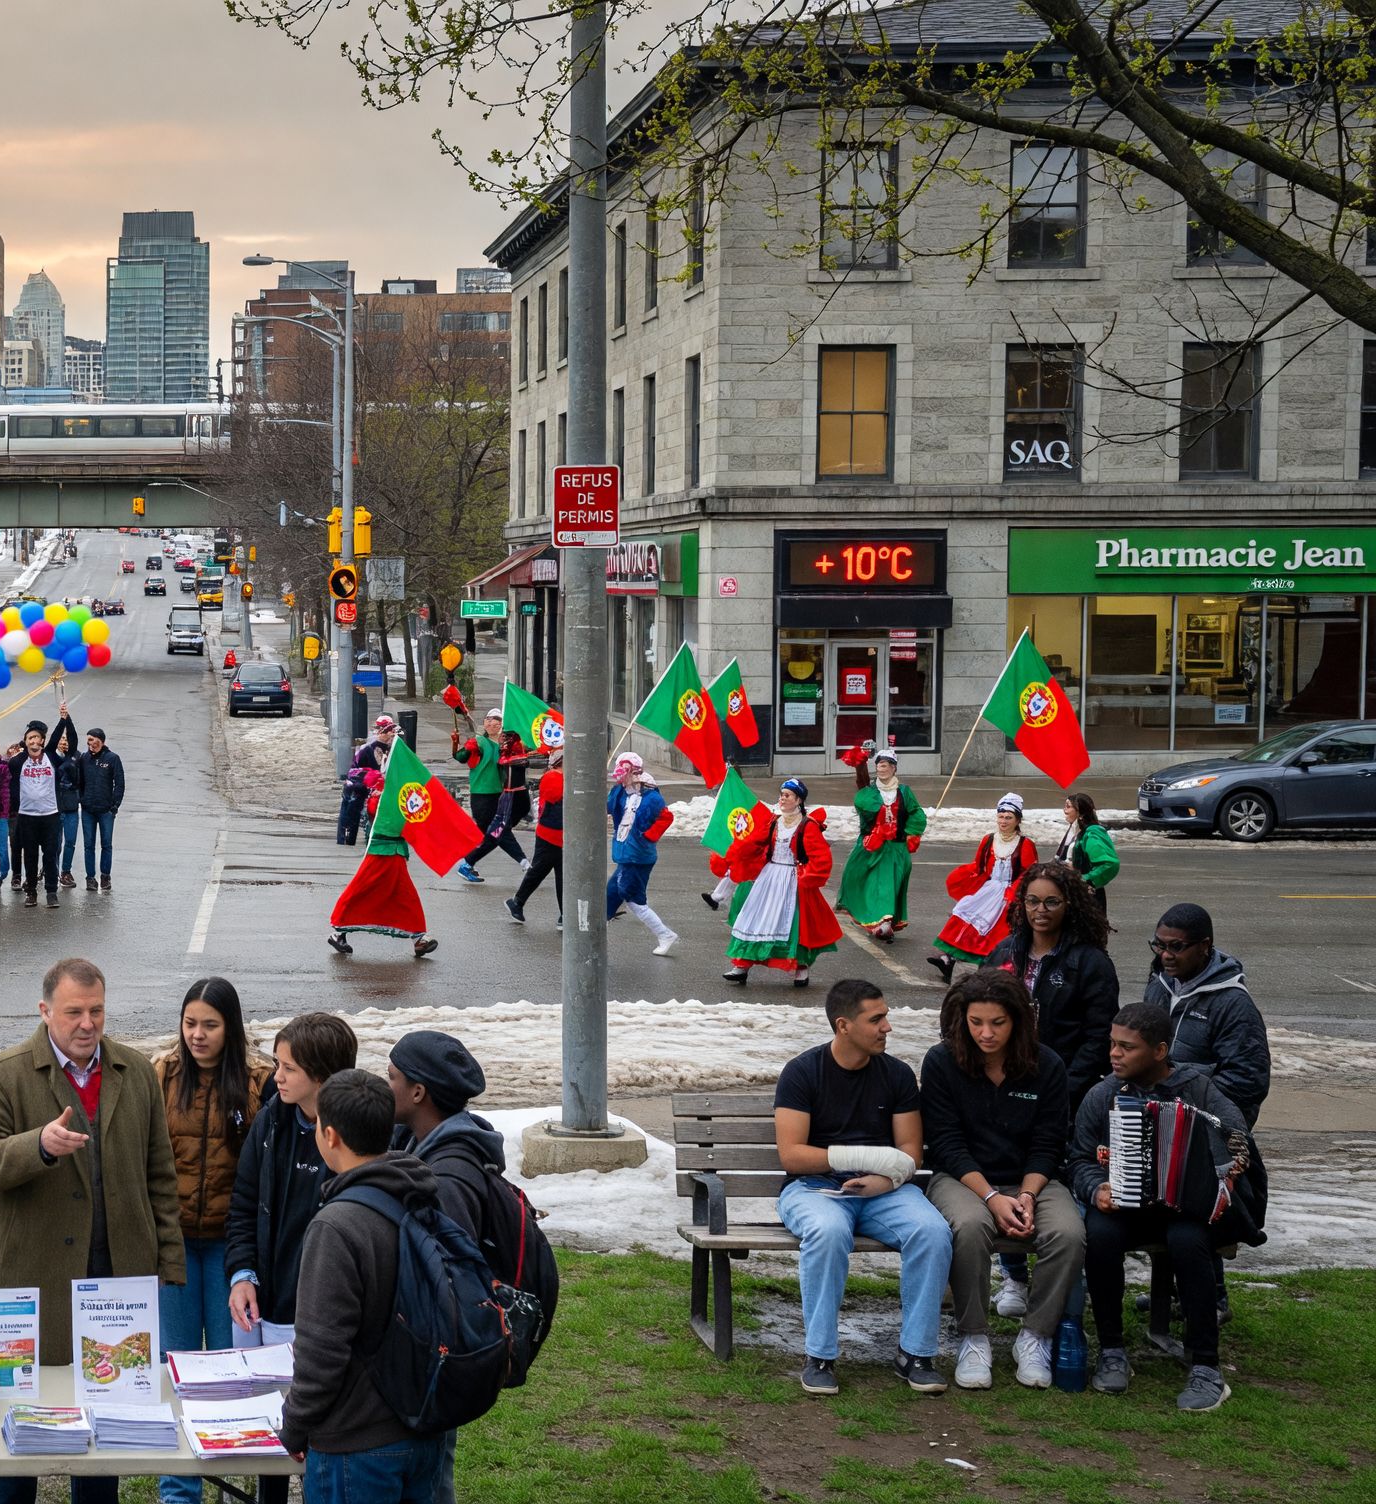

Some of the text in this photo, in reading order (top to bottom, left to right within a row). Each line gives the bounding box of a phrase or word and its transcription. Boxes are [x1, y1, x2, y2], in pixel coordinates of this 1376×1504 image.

[1008, 439, 1073, 469] SAQ
[561, 473, 612, 488] REFUS
[577, 492, 596, 505] DE
[558, 510, 613, 524] PERMIS
[1095, 538, 1365, 570] Pharmacie Jean
